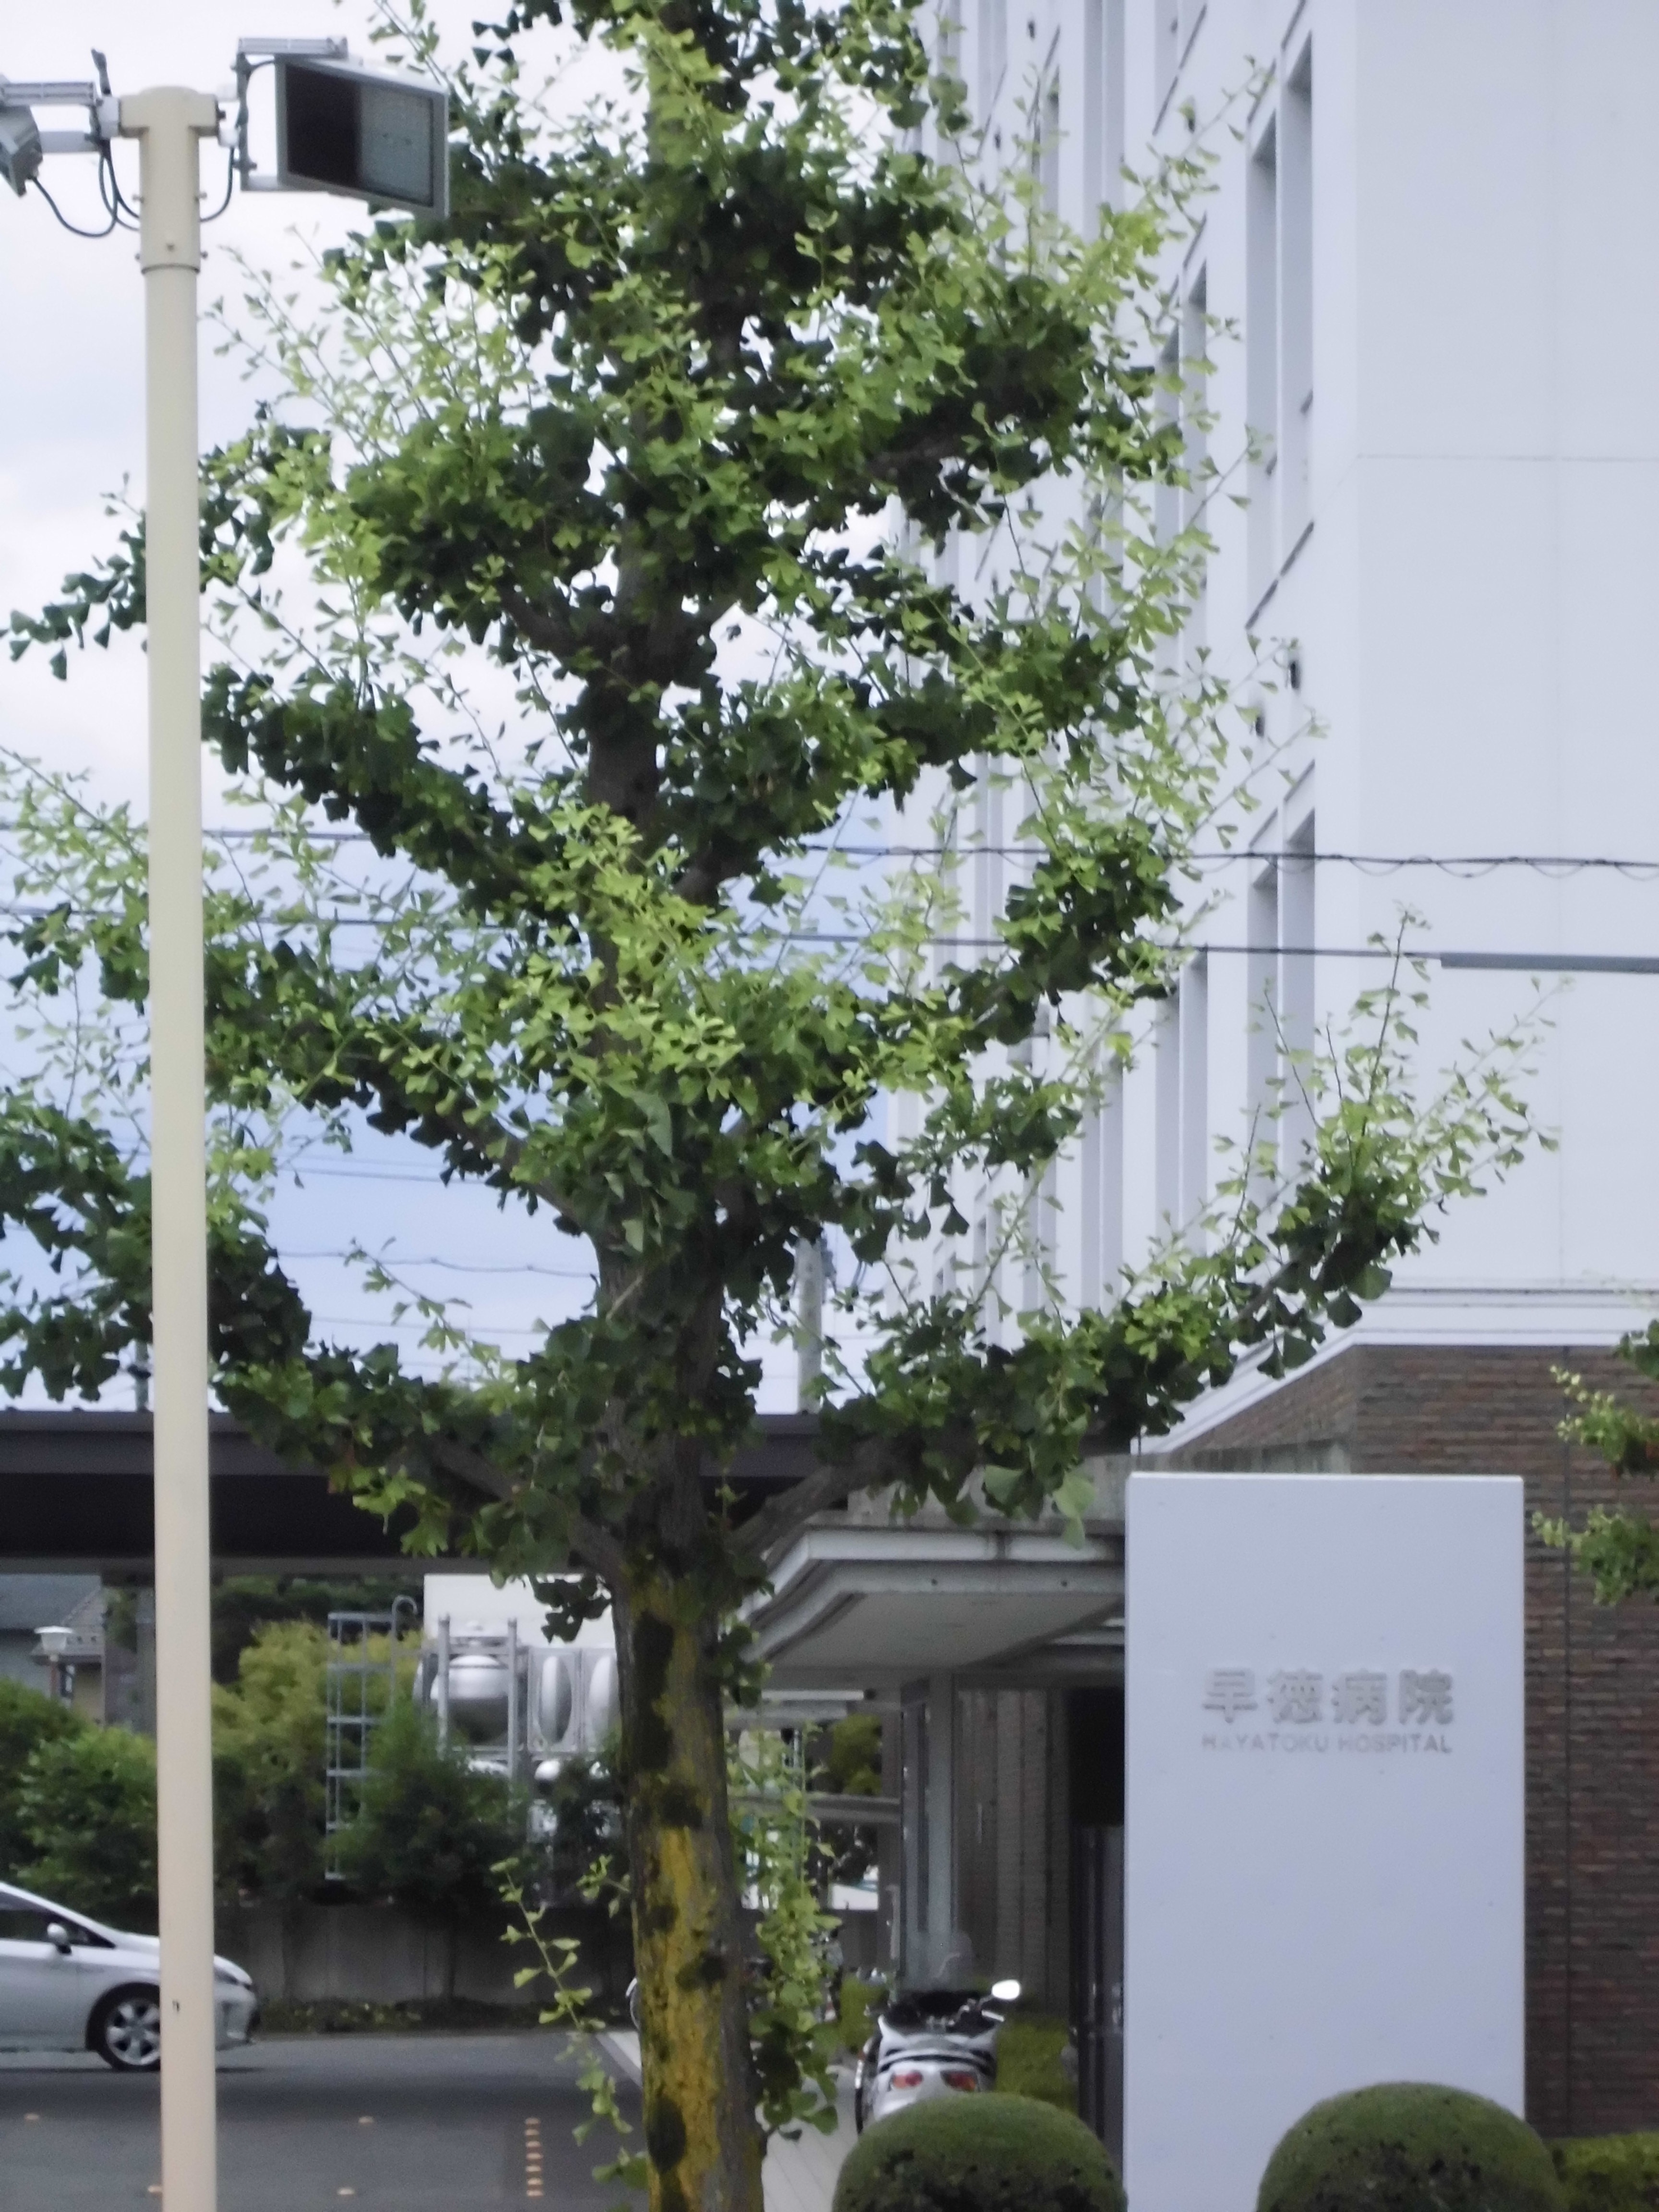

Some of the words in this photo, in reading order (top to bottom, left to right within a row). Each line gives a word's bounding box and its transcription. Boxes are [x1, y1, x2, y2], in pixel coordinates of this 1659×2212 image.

[1202, 1668, 1454, 1725] 早徳病院
[1202, 1732, 1329, 1753] HAYATOKU
[1338, 1732, 1453, 1753] HOSPITAL
